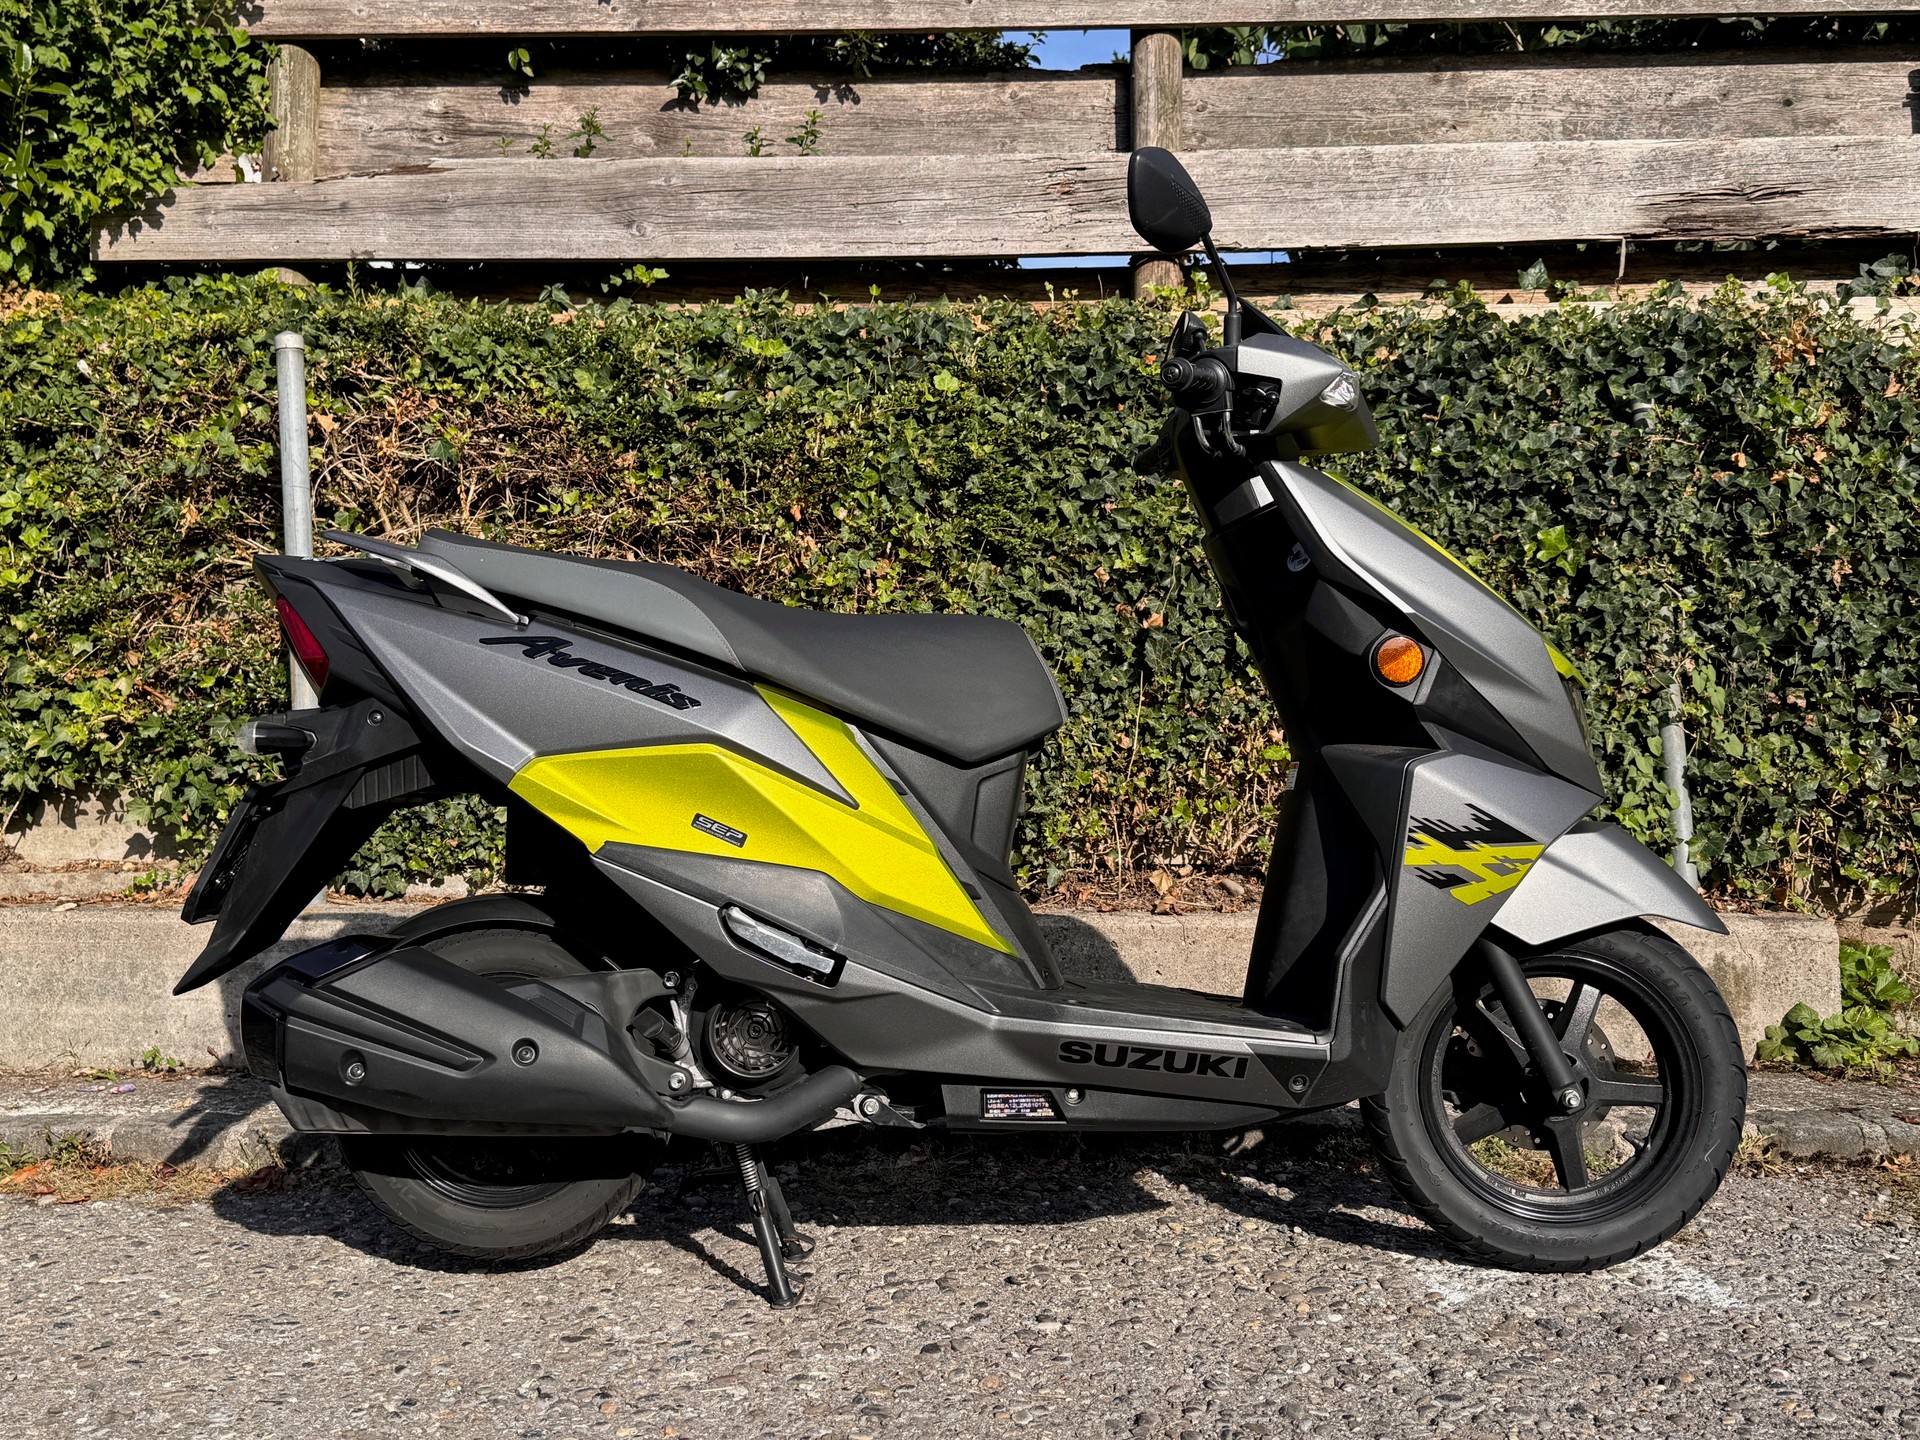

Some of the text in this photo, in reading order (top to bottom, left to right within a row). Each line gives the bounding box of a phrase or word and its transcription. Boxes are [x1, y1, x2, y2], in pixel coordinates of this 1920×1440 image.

[479, 635, 702, 711] Avenis
[695, 816, 744, 839] SEP
[1058, 1040, 1249, 1080] SUZUKI
